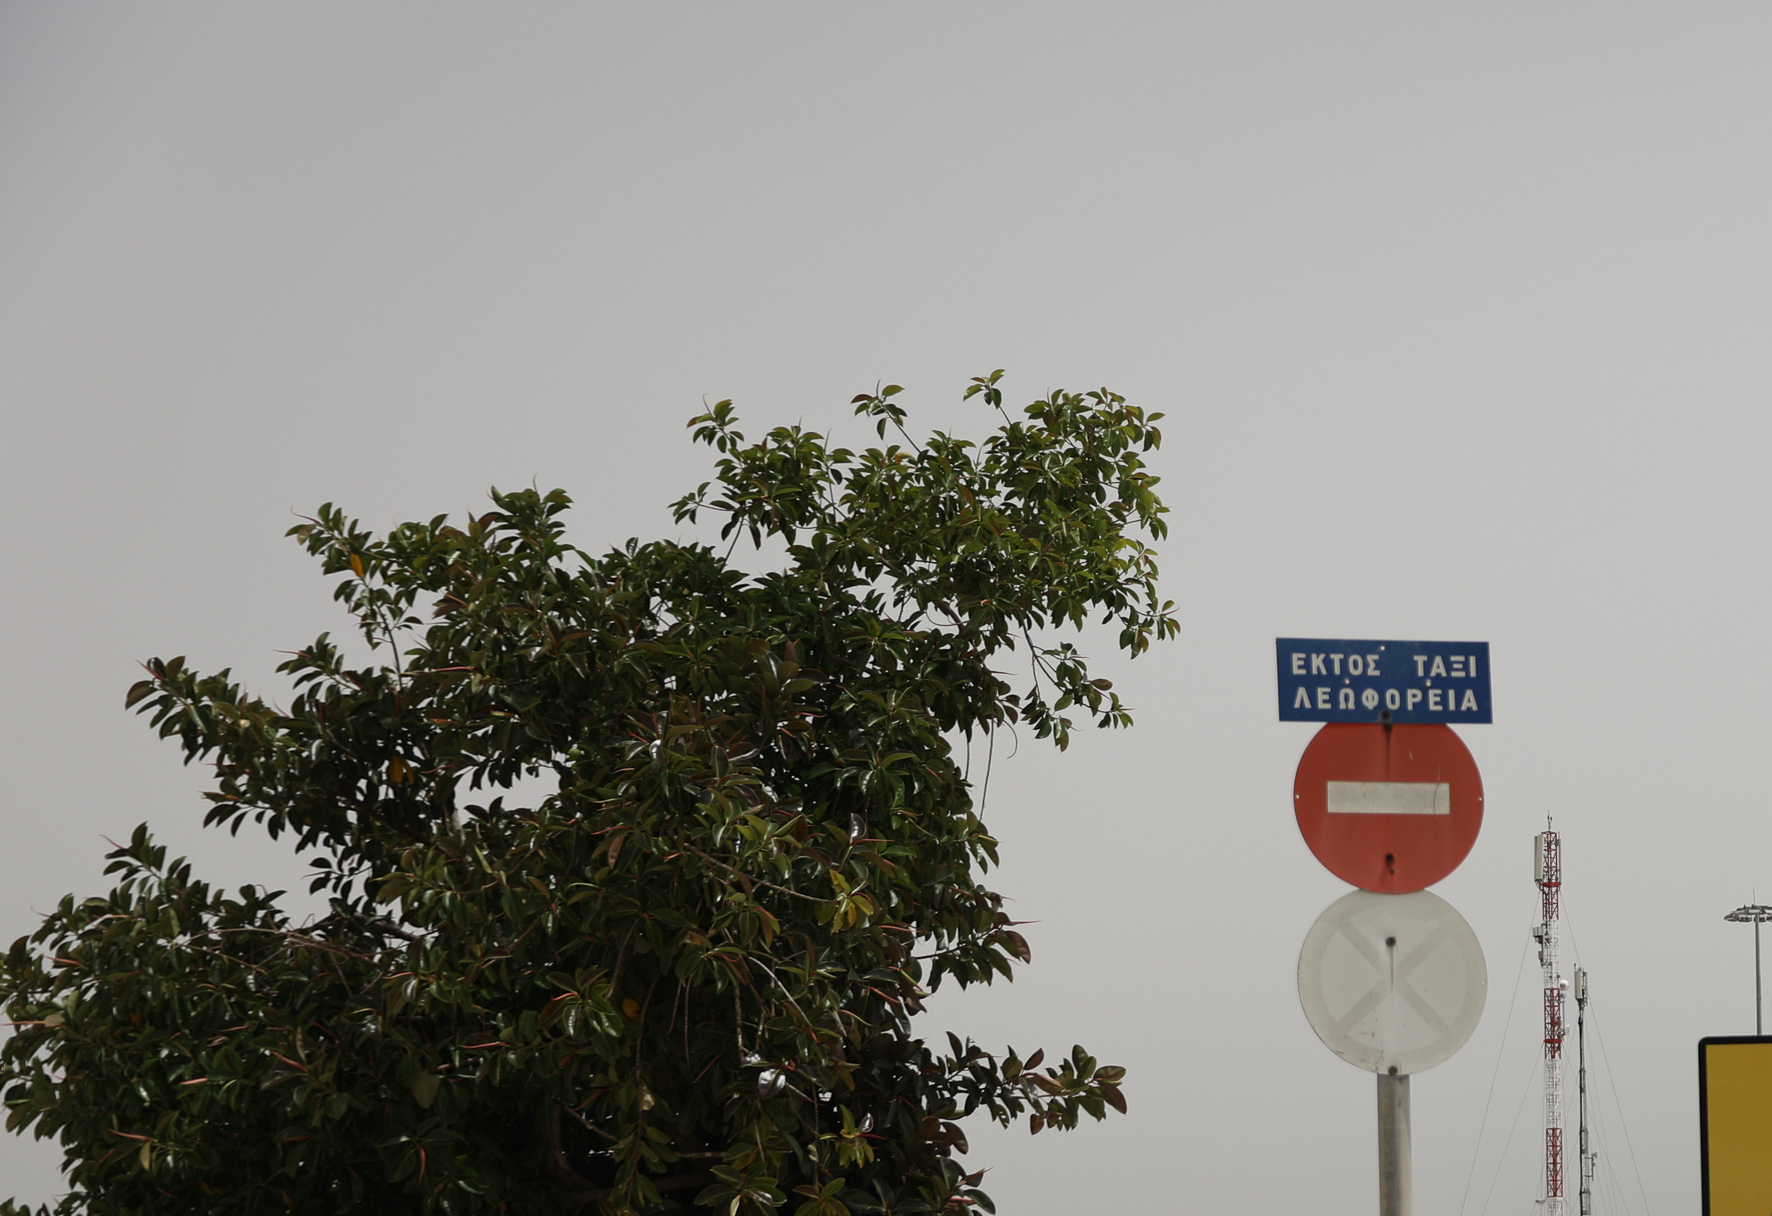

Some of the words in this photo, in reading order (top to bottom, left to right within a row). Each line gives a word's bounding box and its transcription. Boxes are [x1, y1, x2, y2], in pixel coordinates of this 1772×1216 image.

[1291, 652, 1381, 676] ΕΚΤΟΣ
[1413, 655, 1477, 678] ΤΑΞΙ
[1294, 686, 1479, 711] ΛΕΩΦΟΡΕΙΑ
